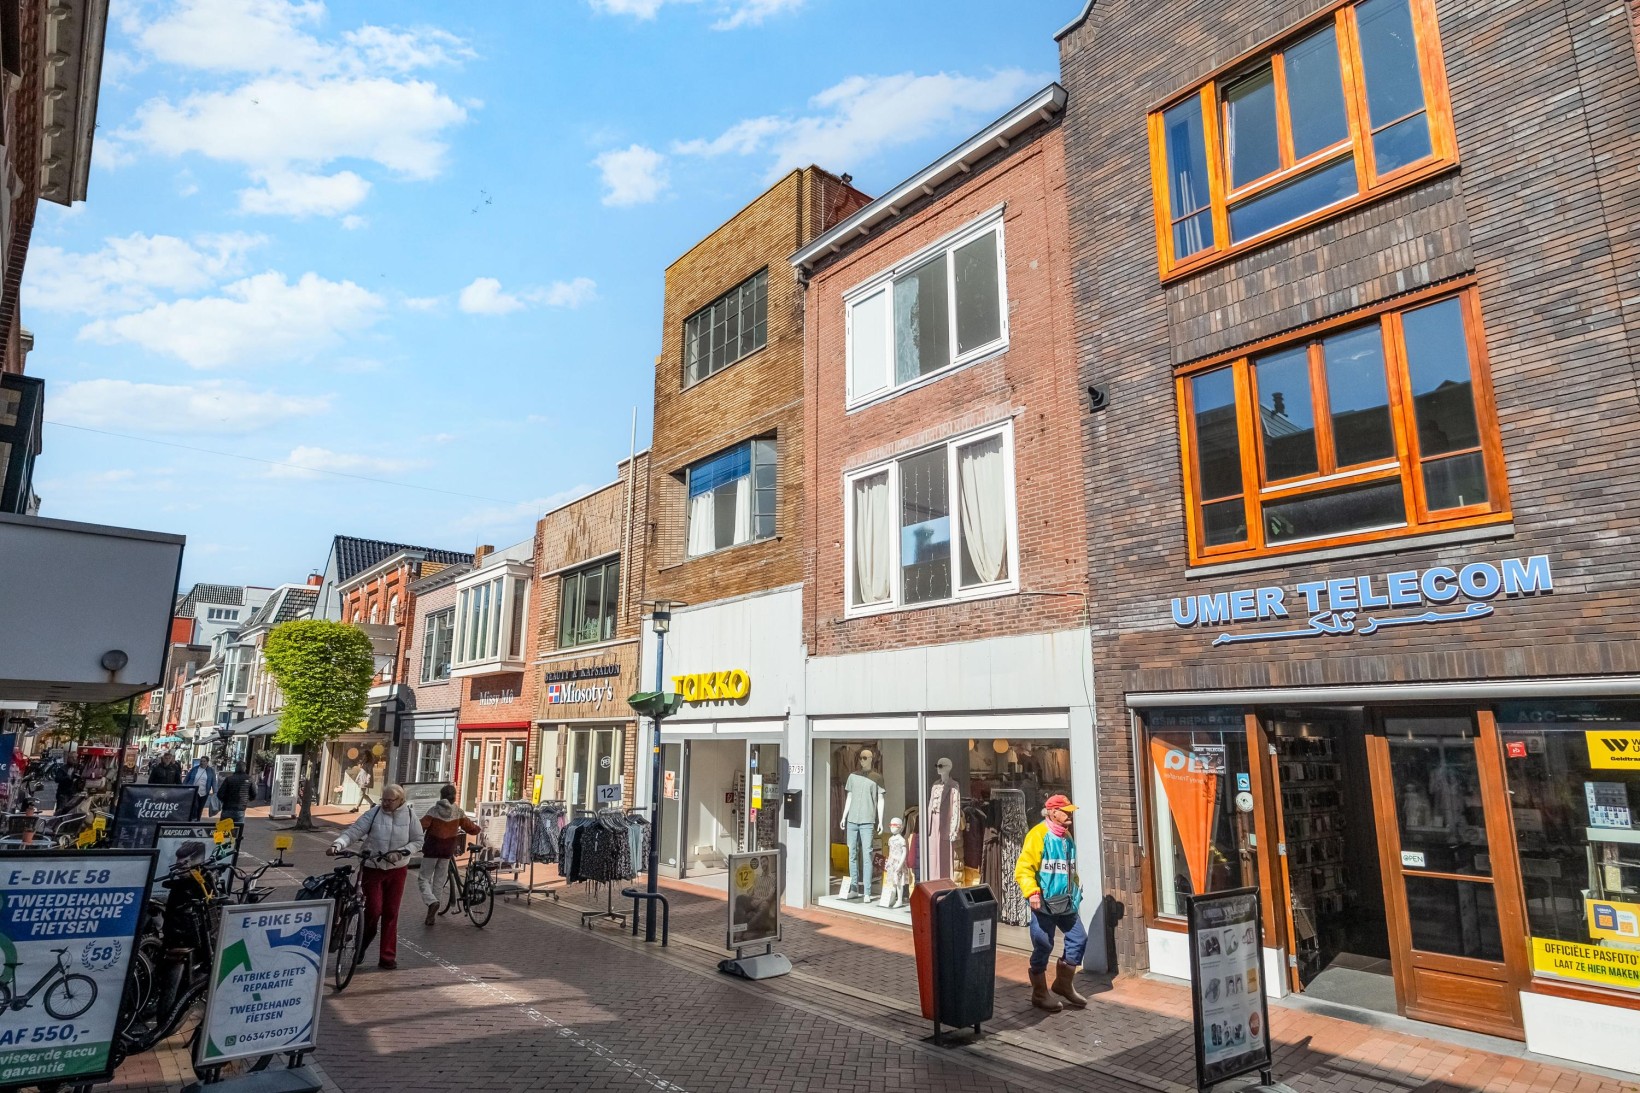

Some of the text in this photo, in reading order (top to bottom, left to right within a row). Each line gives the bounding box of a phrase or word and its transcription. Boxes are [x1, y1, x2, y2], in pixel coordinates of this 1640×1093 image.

[1170, 554, 1554, 627] UMER TELECOM
[479, 691, 500, 710] Missy
[560, 679, 613, 710] Miosoty's
[601, 787, 614, 798] 12
[142, 798, 179, 811] Franse
[137, 808, 173, 819] Keizer
[1403, 855, 1423, 863] OPEN
[8, 869, 110, 885] E-BIKE 58
[7, 892, 135, 908] TWEEDEHANDS
[12, 905, 123, 922] ELEKTRISCHE
[242, 911, 313, 929] E-BIKE 58
[31, 920, 99, 936] FIETSEN
[90, 946, 113, 961] 58
[1544, 942, 1590, 959] OFFICIËLE
[232, 966, 306, 983] FATBIKE & FIETS
[1554, 959, 1639, 979] LAAT ZE HIER MAKEN
[243, 979, 294, 993] REPARATIE
[229, 997, 302, 1015] TWEEDEHANDS
[31, 1024, 90, 1043] 550,-
[239, 1026, 299, 1043] 0634750731
[65, 1046, 97, 1058] accu
[2, 1062, 65, 1080] garantie
